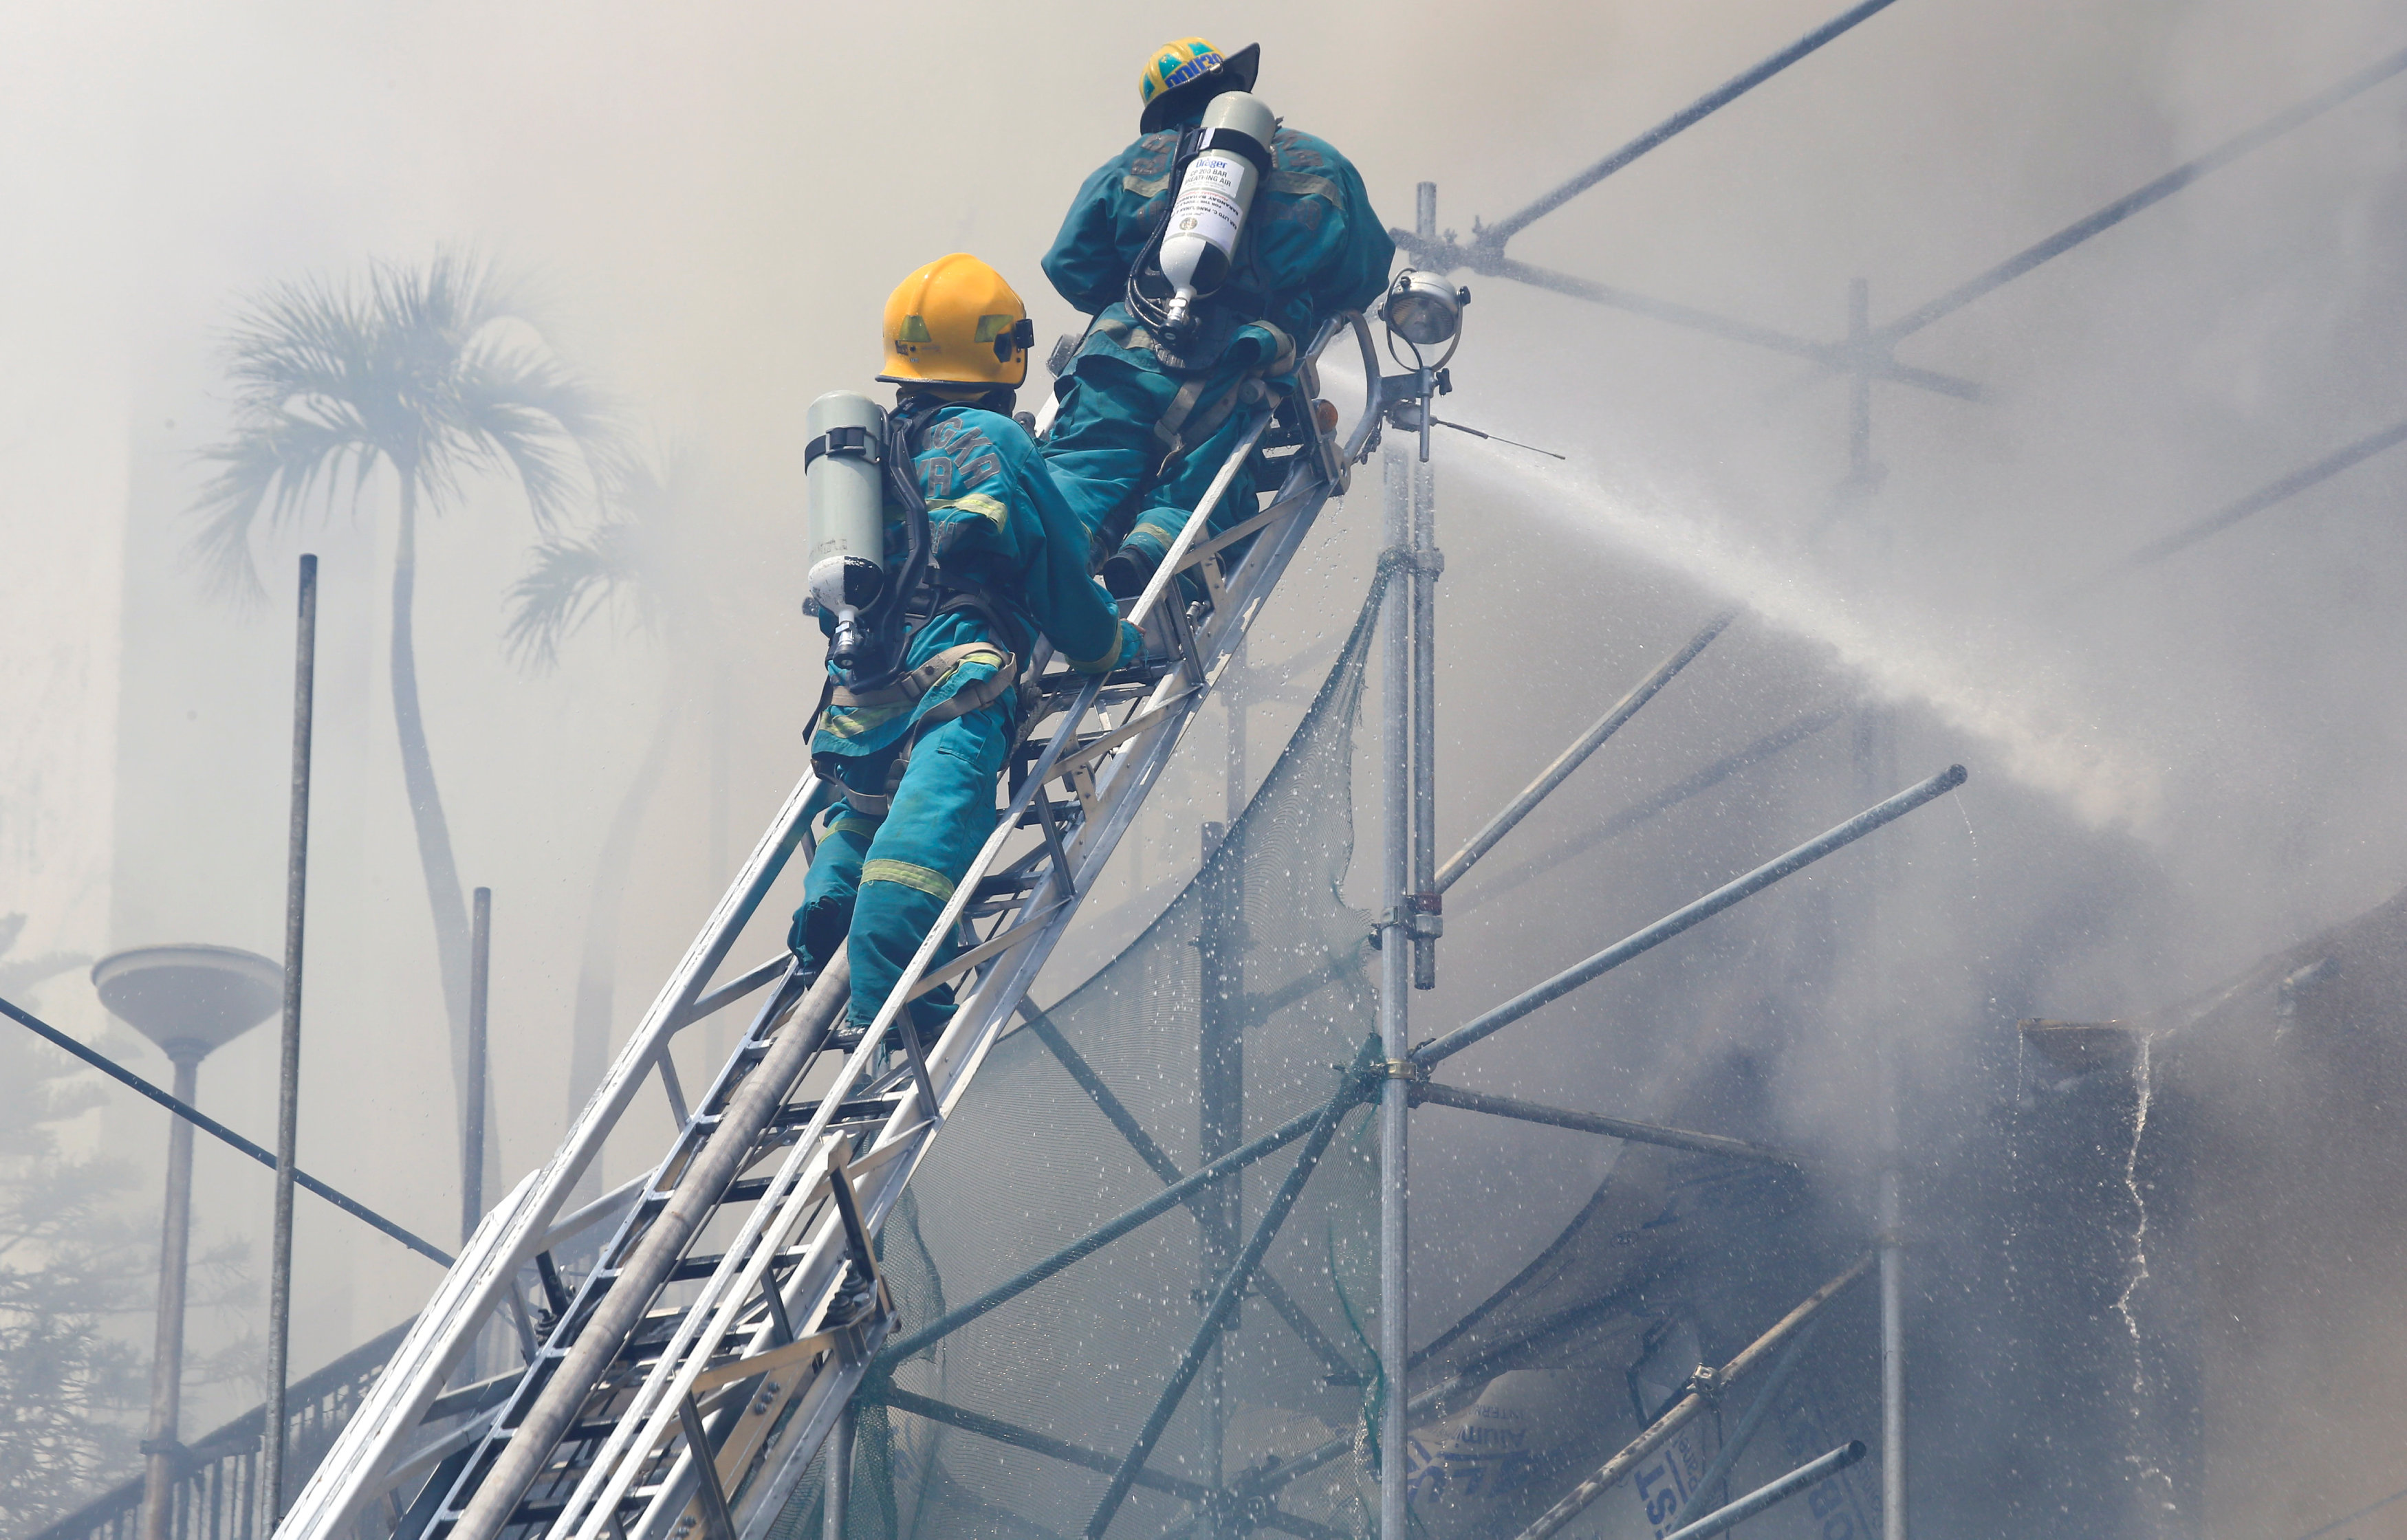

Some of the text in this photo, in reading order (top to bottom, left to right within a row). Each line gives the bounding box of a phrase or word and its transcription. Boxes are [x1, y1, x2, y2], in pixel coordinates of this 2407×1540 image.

[1212, 169, 1228, 178] BAR
[1219, 179, 1232, 187] AIR
[1218, 212, 1230, 222] LITO
